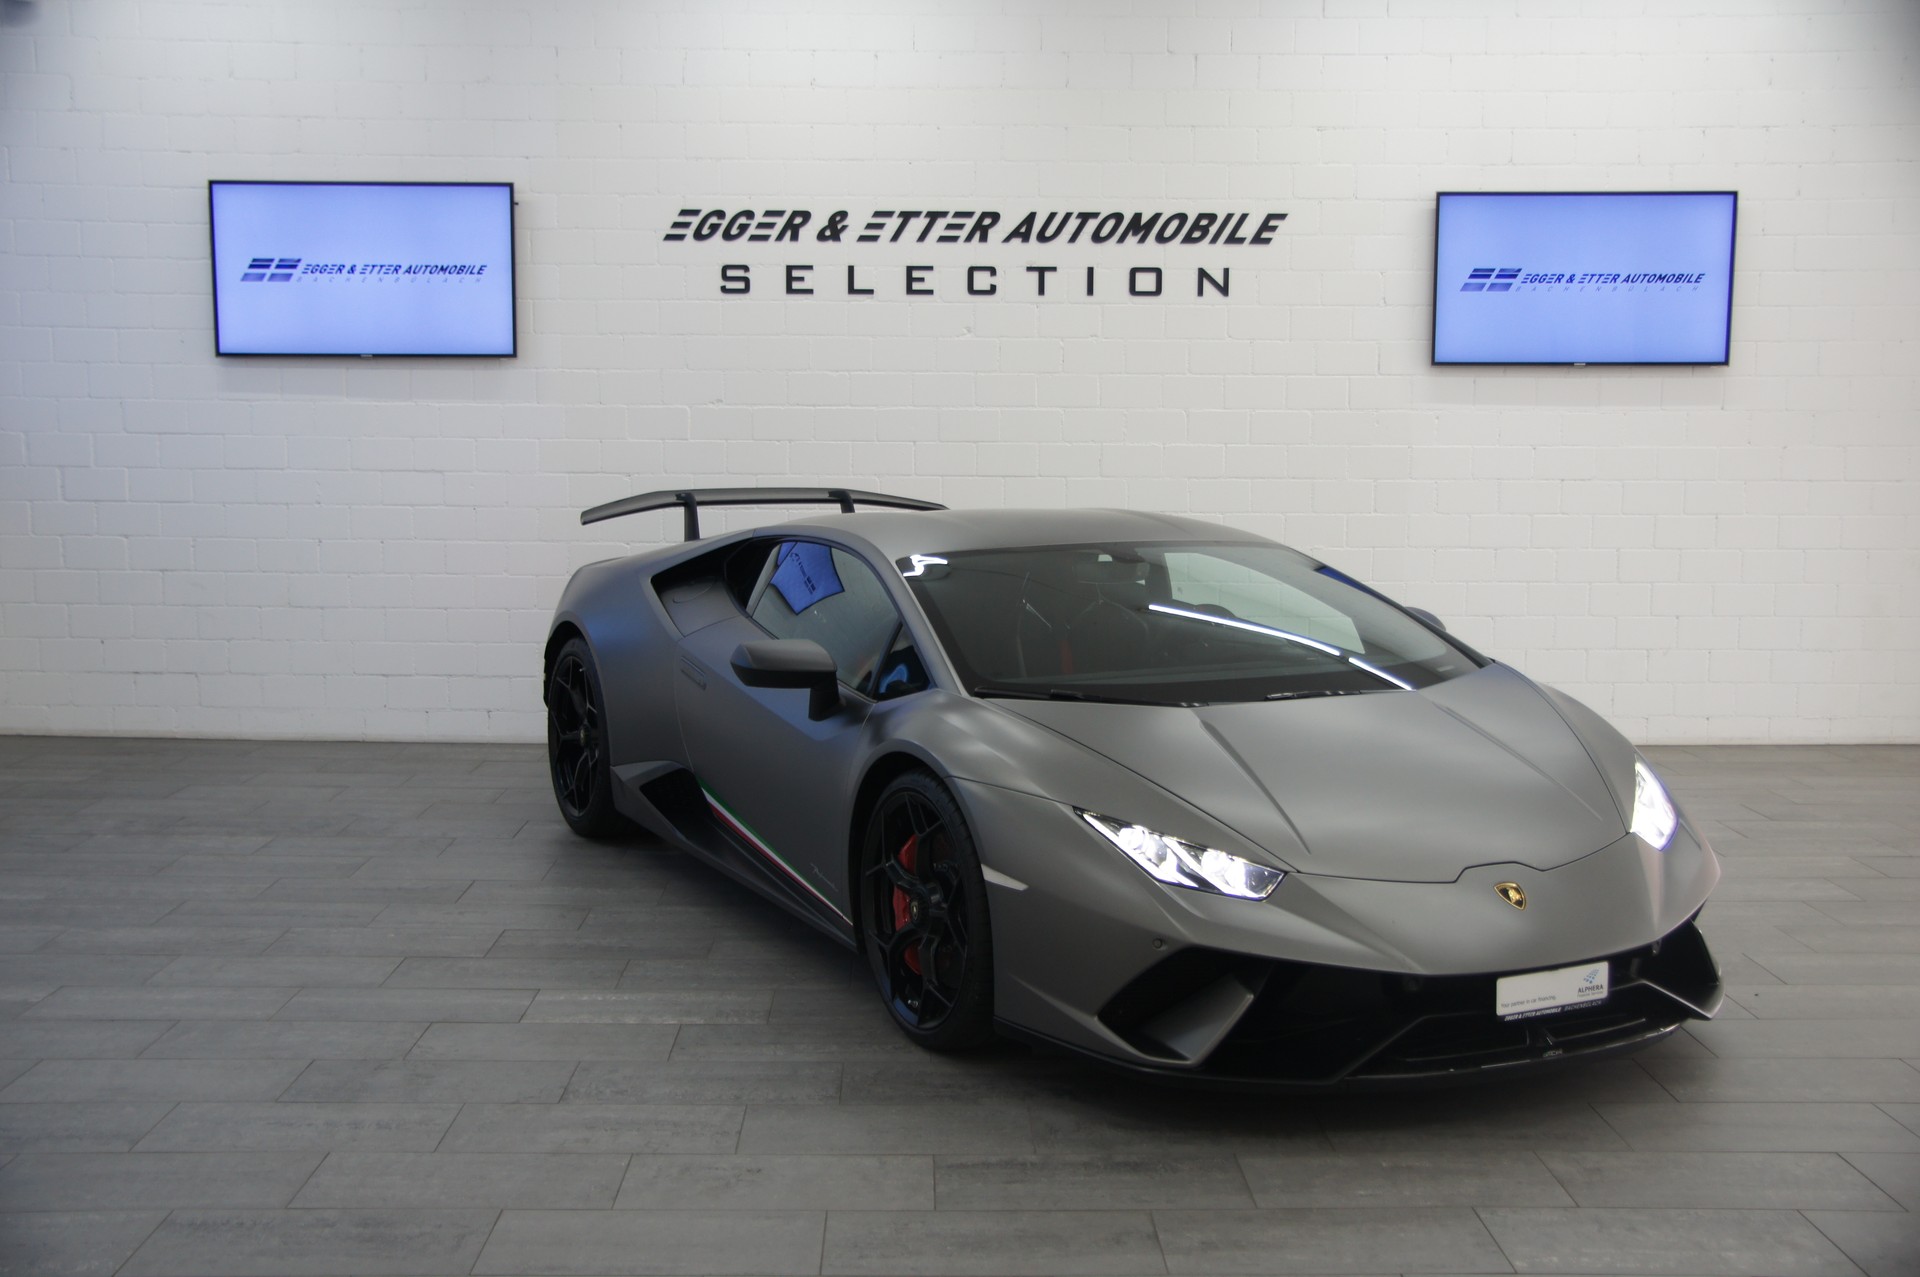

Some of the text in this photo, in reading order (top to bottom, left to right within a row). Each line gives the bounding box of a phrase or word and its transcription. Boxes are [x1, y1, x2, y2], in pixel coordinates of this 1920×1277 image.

[663, 208, 1289, 245] EGGER & ETTER AUTOMOBILE
[301, 264, 488, 275] EGGER & ETTER AUTOMOBILE
[720, 264, 1230, 297] SELECTION
[1520, 273, 1706, 284] EGGER & ETTER AUTOMOBILE
[1577, 983, 1604, 993] ALPHERA
